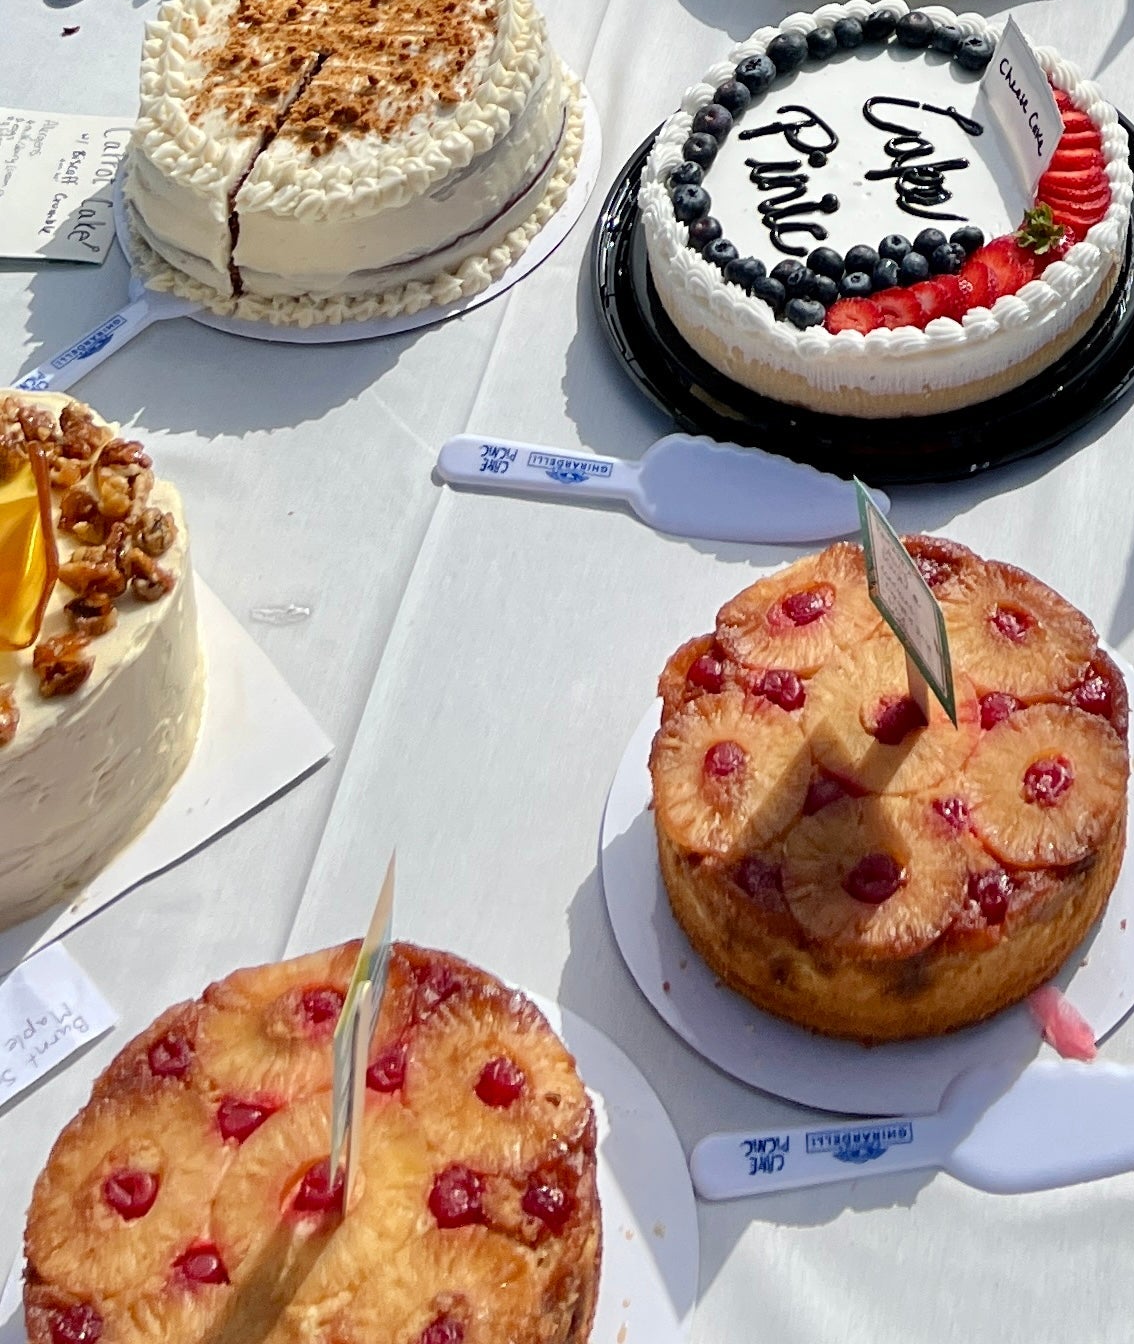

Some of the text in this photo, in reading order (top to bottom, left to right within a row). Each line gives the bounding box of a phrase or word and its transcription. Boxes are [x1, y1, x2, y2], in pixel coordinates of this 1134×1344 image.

[863, 96, 985, 222] Cake
[55, 318, 122, 367] GHIRARDELLI
[480, 460, 509, 474] CAKE
[532, 454, 608, 473] GHIRARDELLI
[5, 1001, 73, 1053] Maple
[25, 1015, 90, 1069] Burnt
[811, 1126, 908, 1148] GHIRARDELLI
[749, 1156, 785, 1176] CAKE
